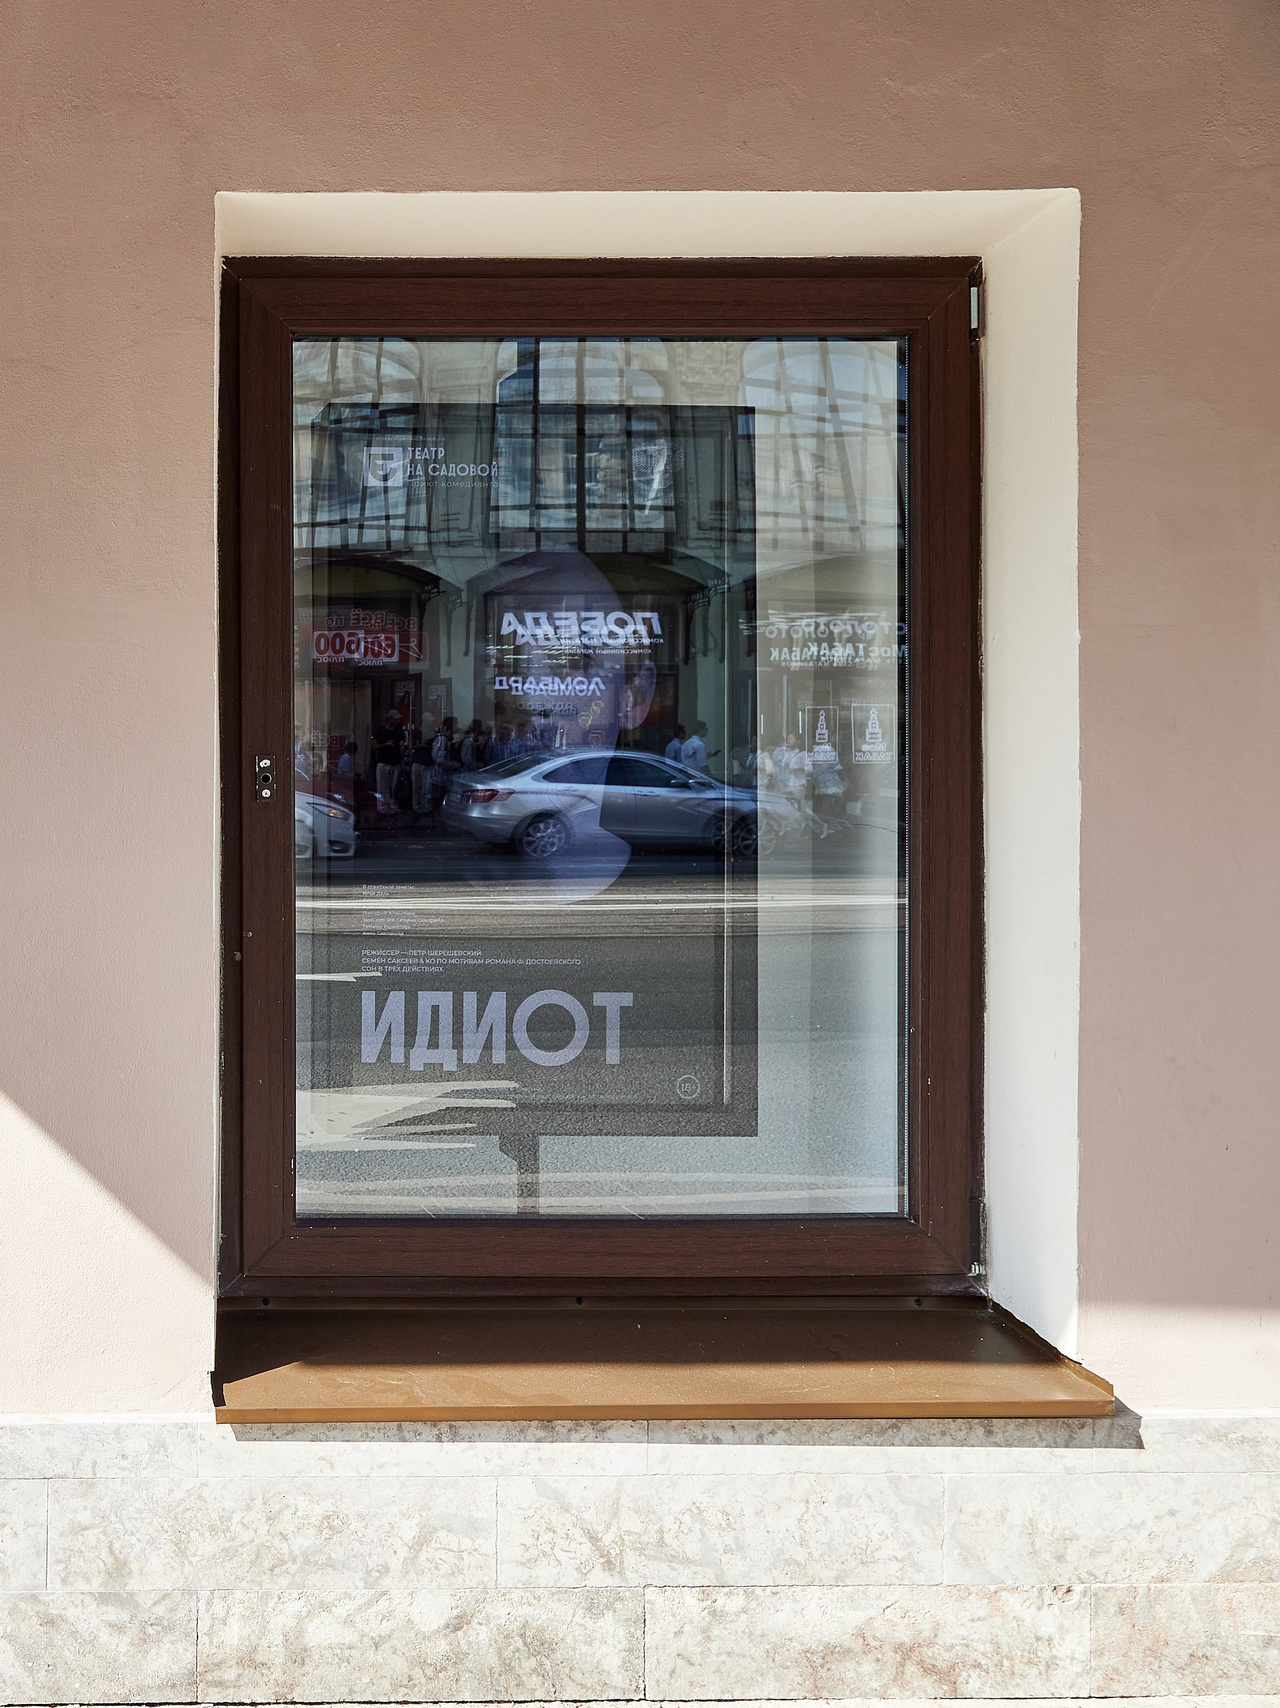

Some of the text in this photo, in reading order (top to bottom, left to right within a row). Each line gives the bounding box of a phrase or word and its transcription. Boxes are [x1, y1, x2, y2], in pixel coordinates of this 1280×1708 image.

[407, 447, 445, 460] ТЕАТР
[407, 461, 498, 477] НА САДОВОЙ
[361, 989, 634, 1071] ИДИОТ
